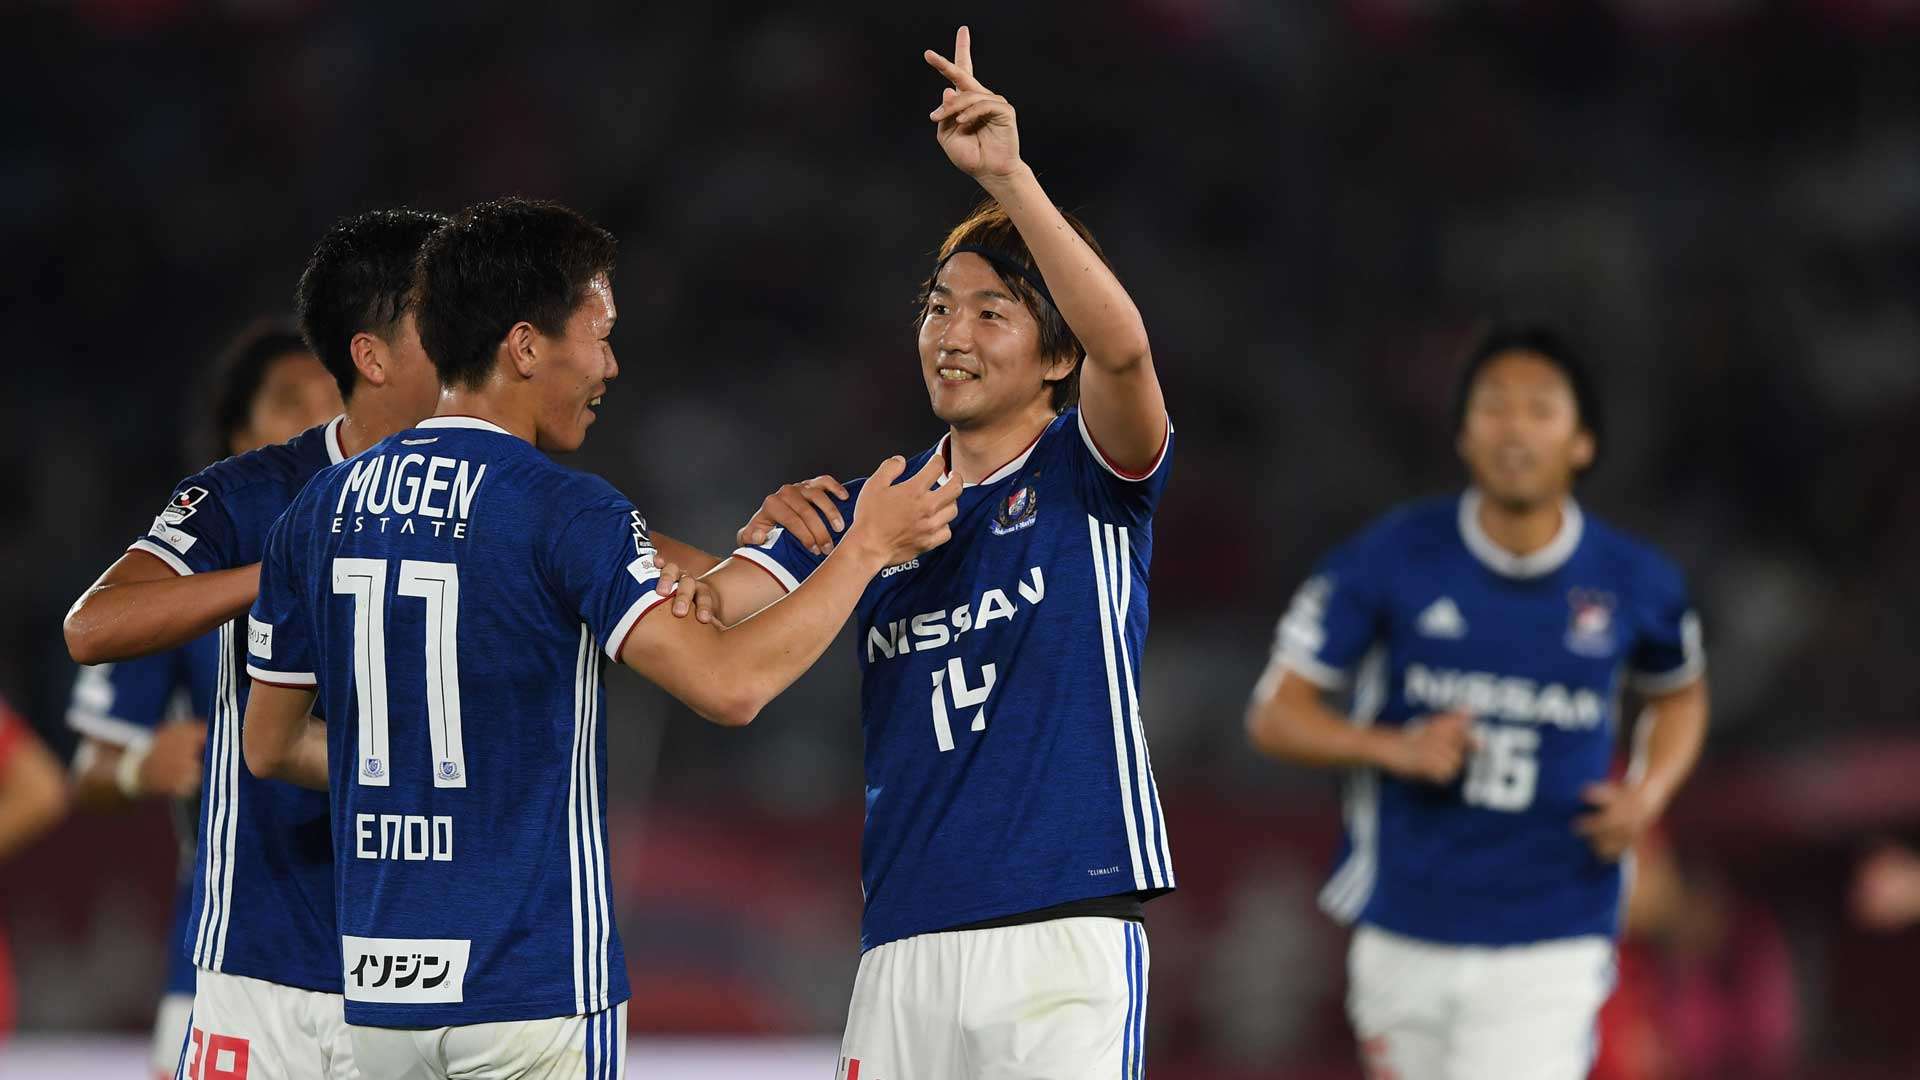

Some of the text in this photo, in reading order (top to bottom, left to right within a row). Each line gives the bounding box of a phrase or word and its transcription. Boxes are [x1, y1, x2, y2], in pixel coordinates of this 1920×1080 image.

[336, 453, 487, 519] MUGEN
[331, 516, 467, 539] ESTATE
[867, 566, 1045, 664] NISSAN
[333, 558, 467, 788] 11
[931, 656, 997, 752] 14
[356, 813, 453, 861] ENDO
[350, 953, 450, 989] イソジン
